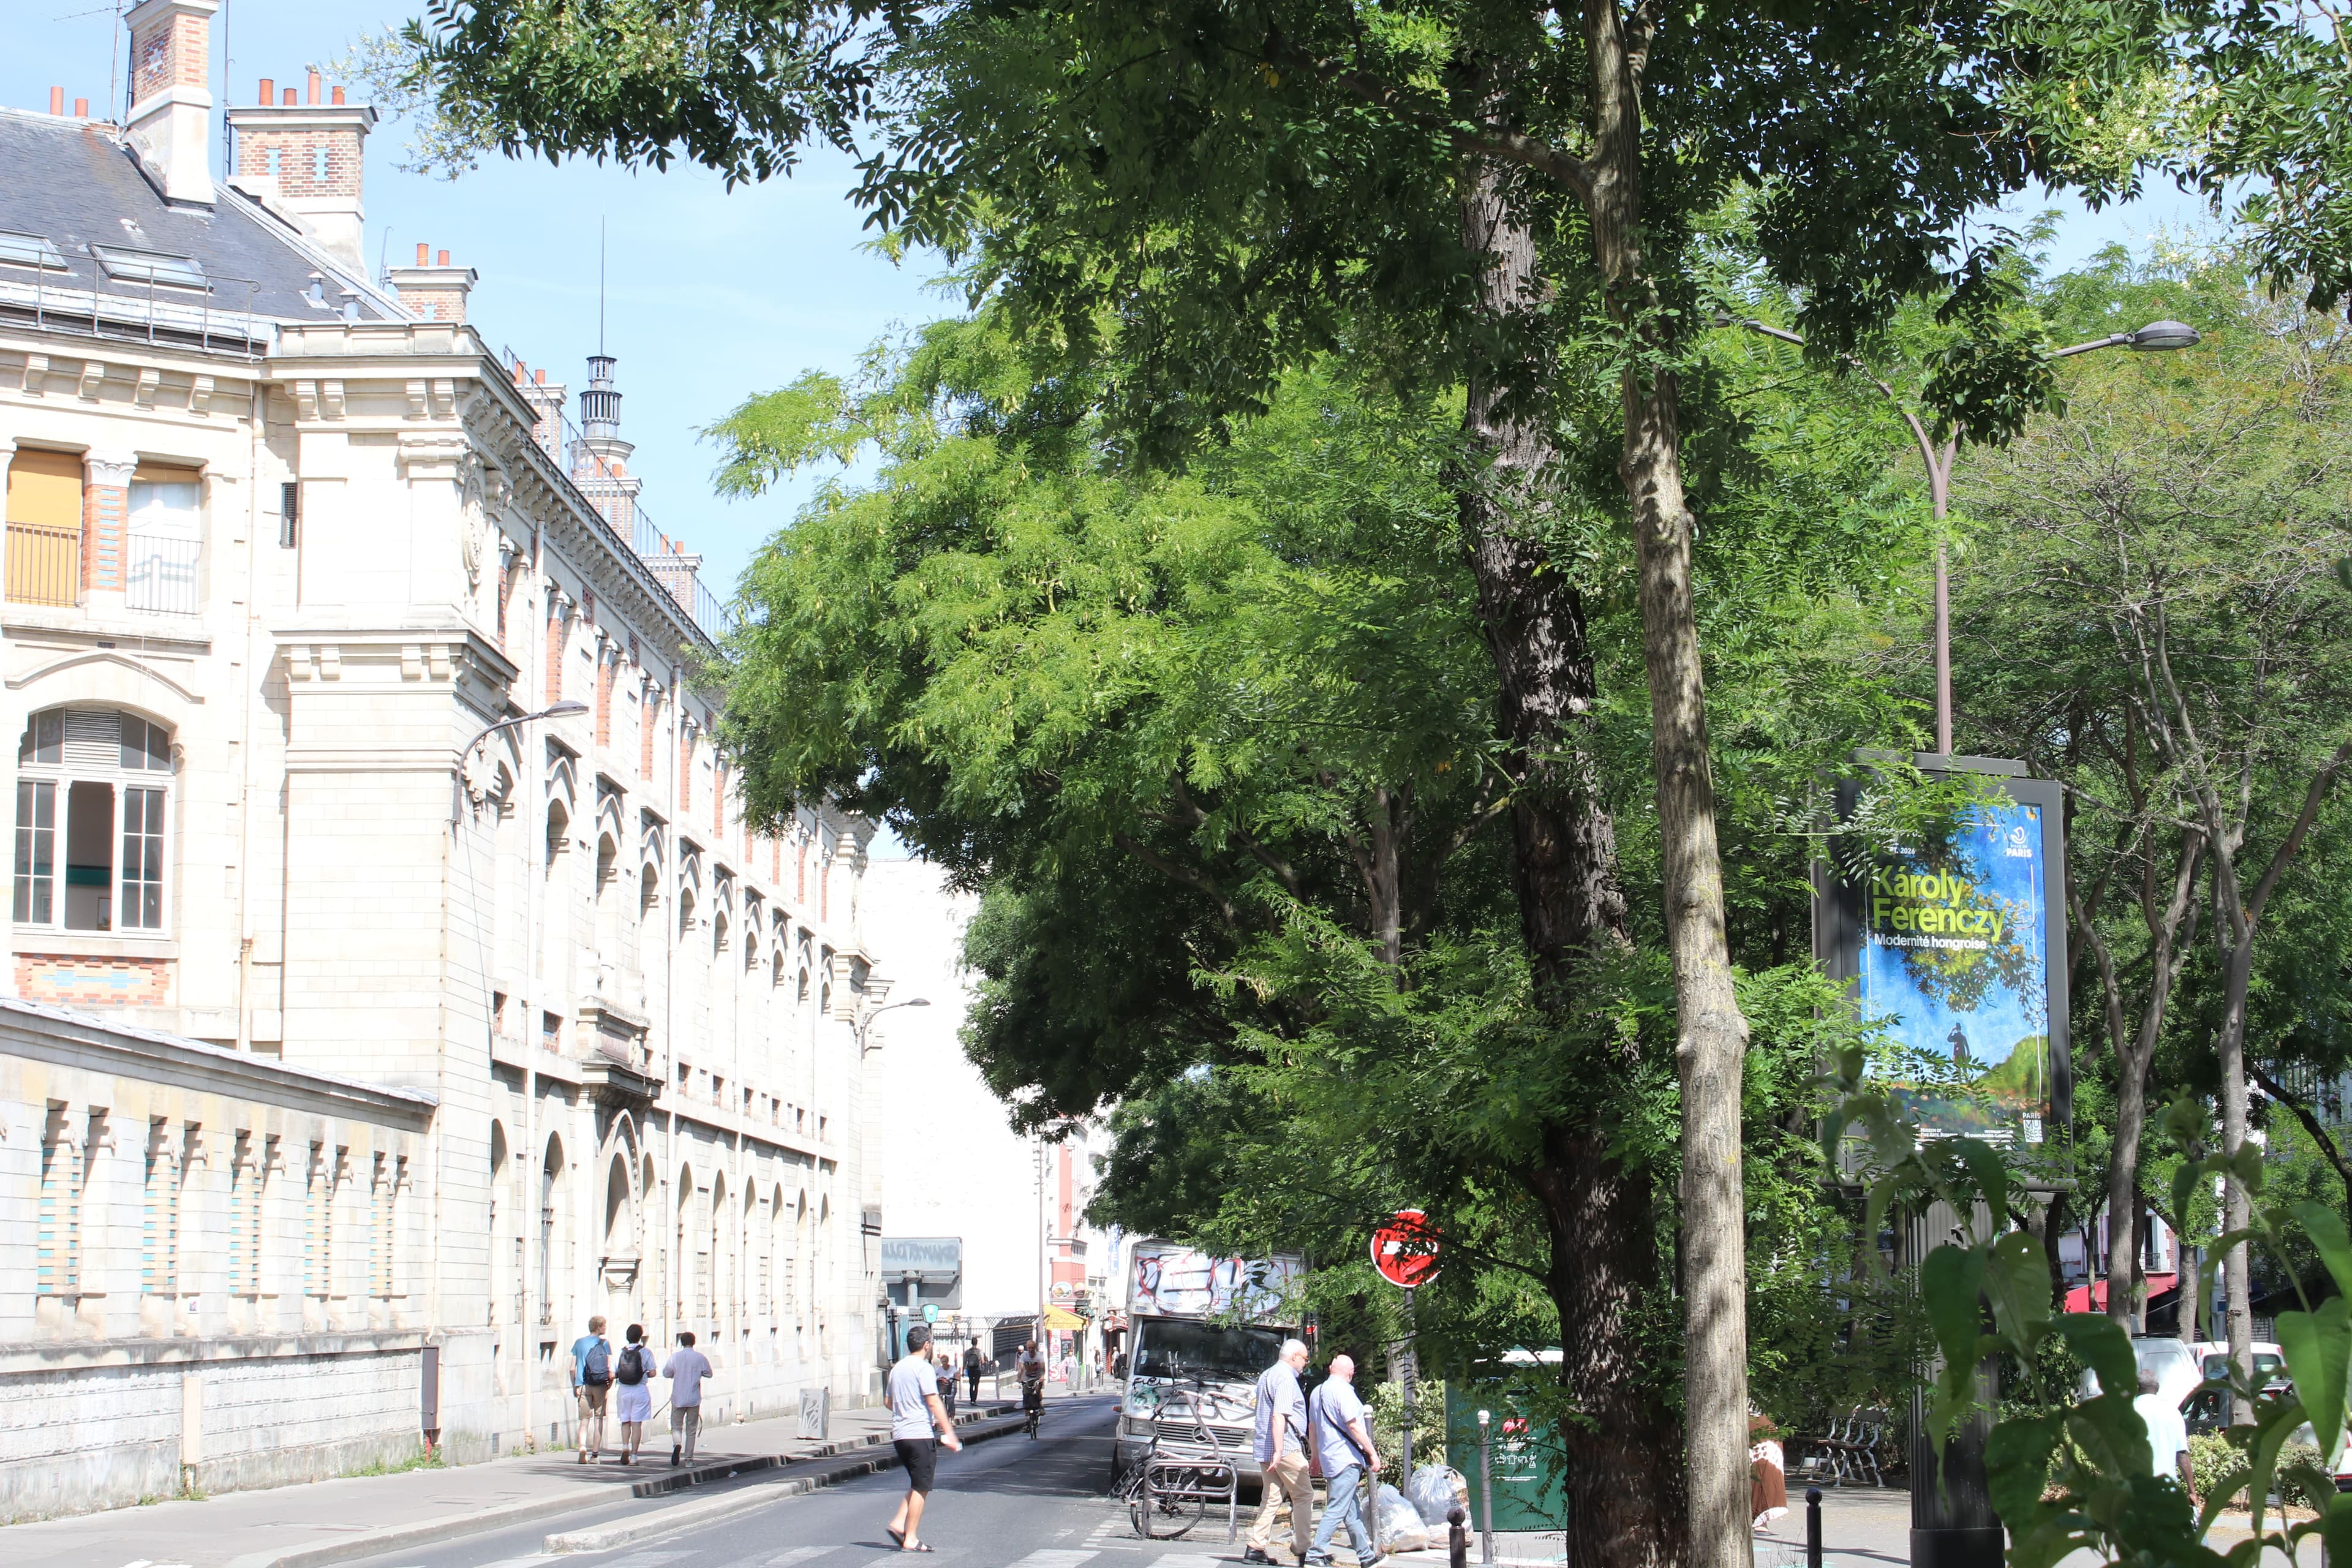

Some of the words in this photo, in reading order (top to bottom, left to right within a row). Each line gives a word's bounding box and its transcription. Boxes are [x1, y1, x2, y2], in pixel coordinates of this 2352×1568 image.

[2006, 848, 2032, 858] PARIS
[1872, 864, 1965, 908] Károly
[1873, 898, 2005, 942] Ferenczy
[1874, 933, 1929, 948] Modernité
[1931, 937, 1987, 951] hongroise
